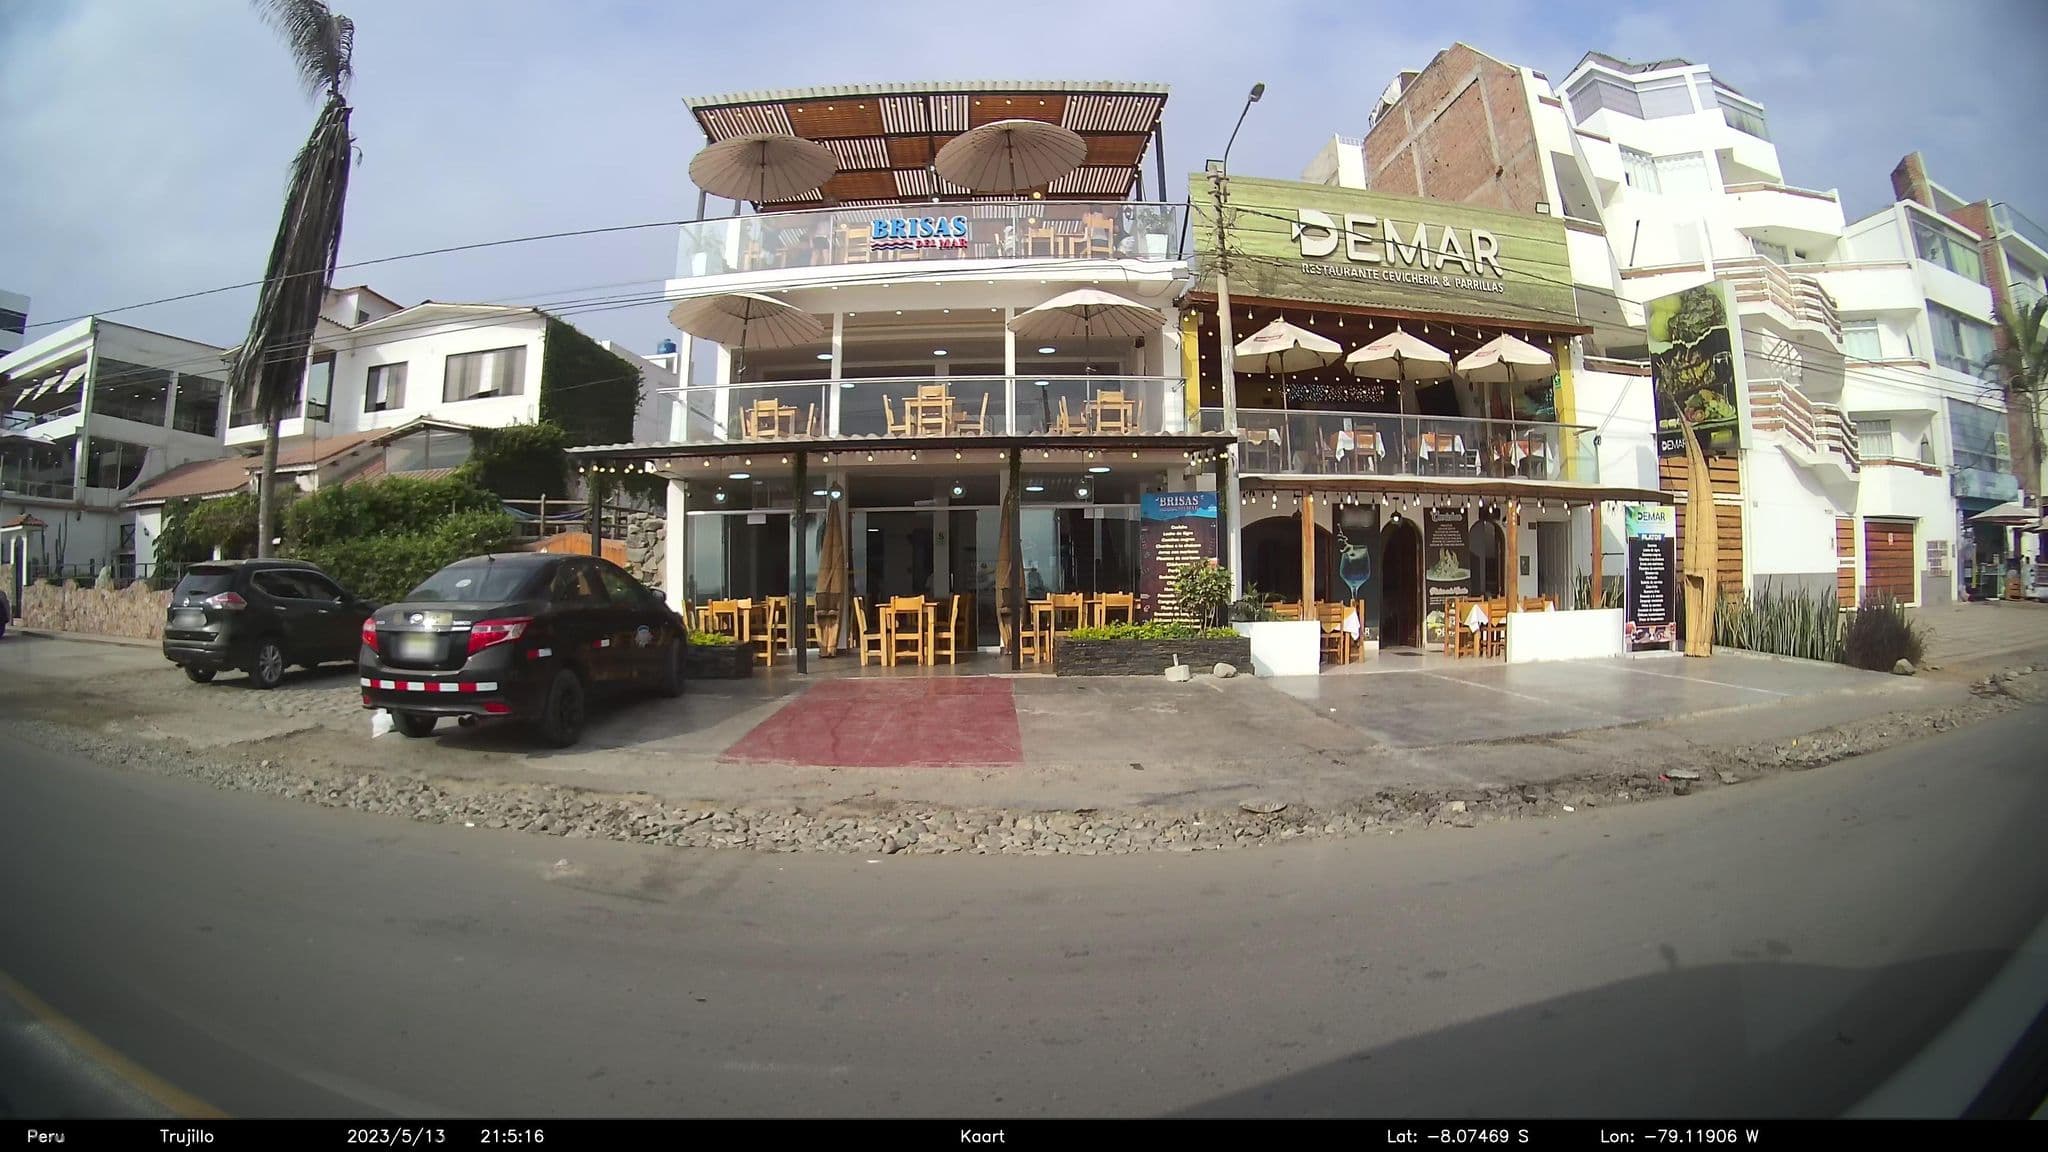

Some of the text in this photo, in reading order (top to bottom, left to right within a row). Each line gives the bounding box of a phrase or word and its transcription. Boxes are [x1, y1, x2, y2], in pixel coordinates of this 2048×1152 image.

[872, 216, 967, 239] BRISAS
[939, 239, 967, 250] MAR
[1291, 208, 1504, 277] DEMAR
[1302, 263, 1504, 294] RESTAURANTE CEVICHERIA & PARRILLAS
[1160, 495, 1199, 507] BRISAS
[1637, 511, 1666, 521] DEMAR
